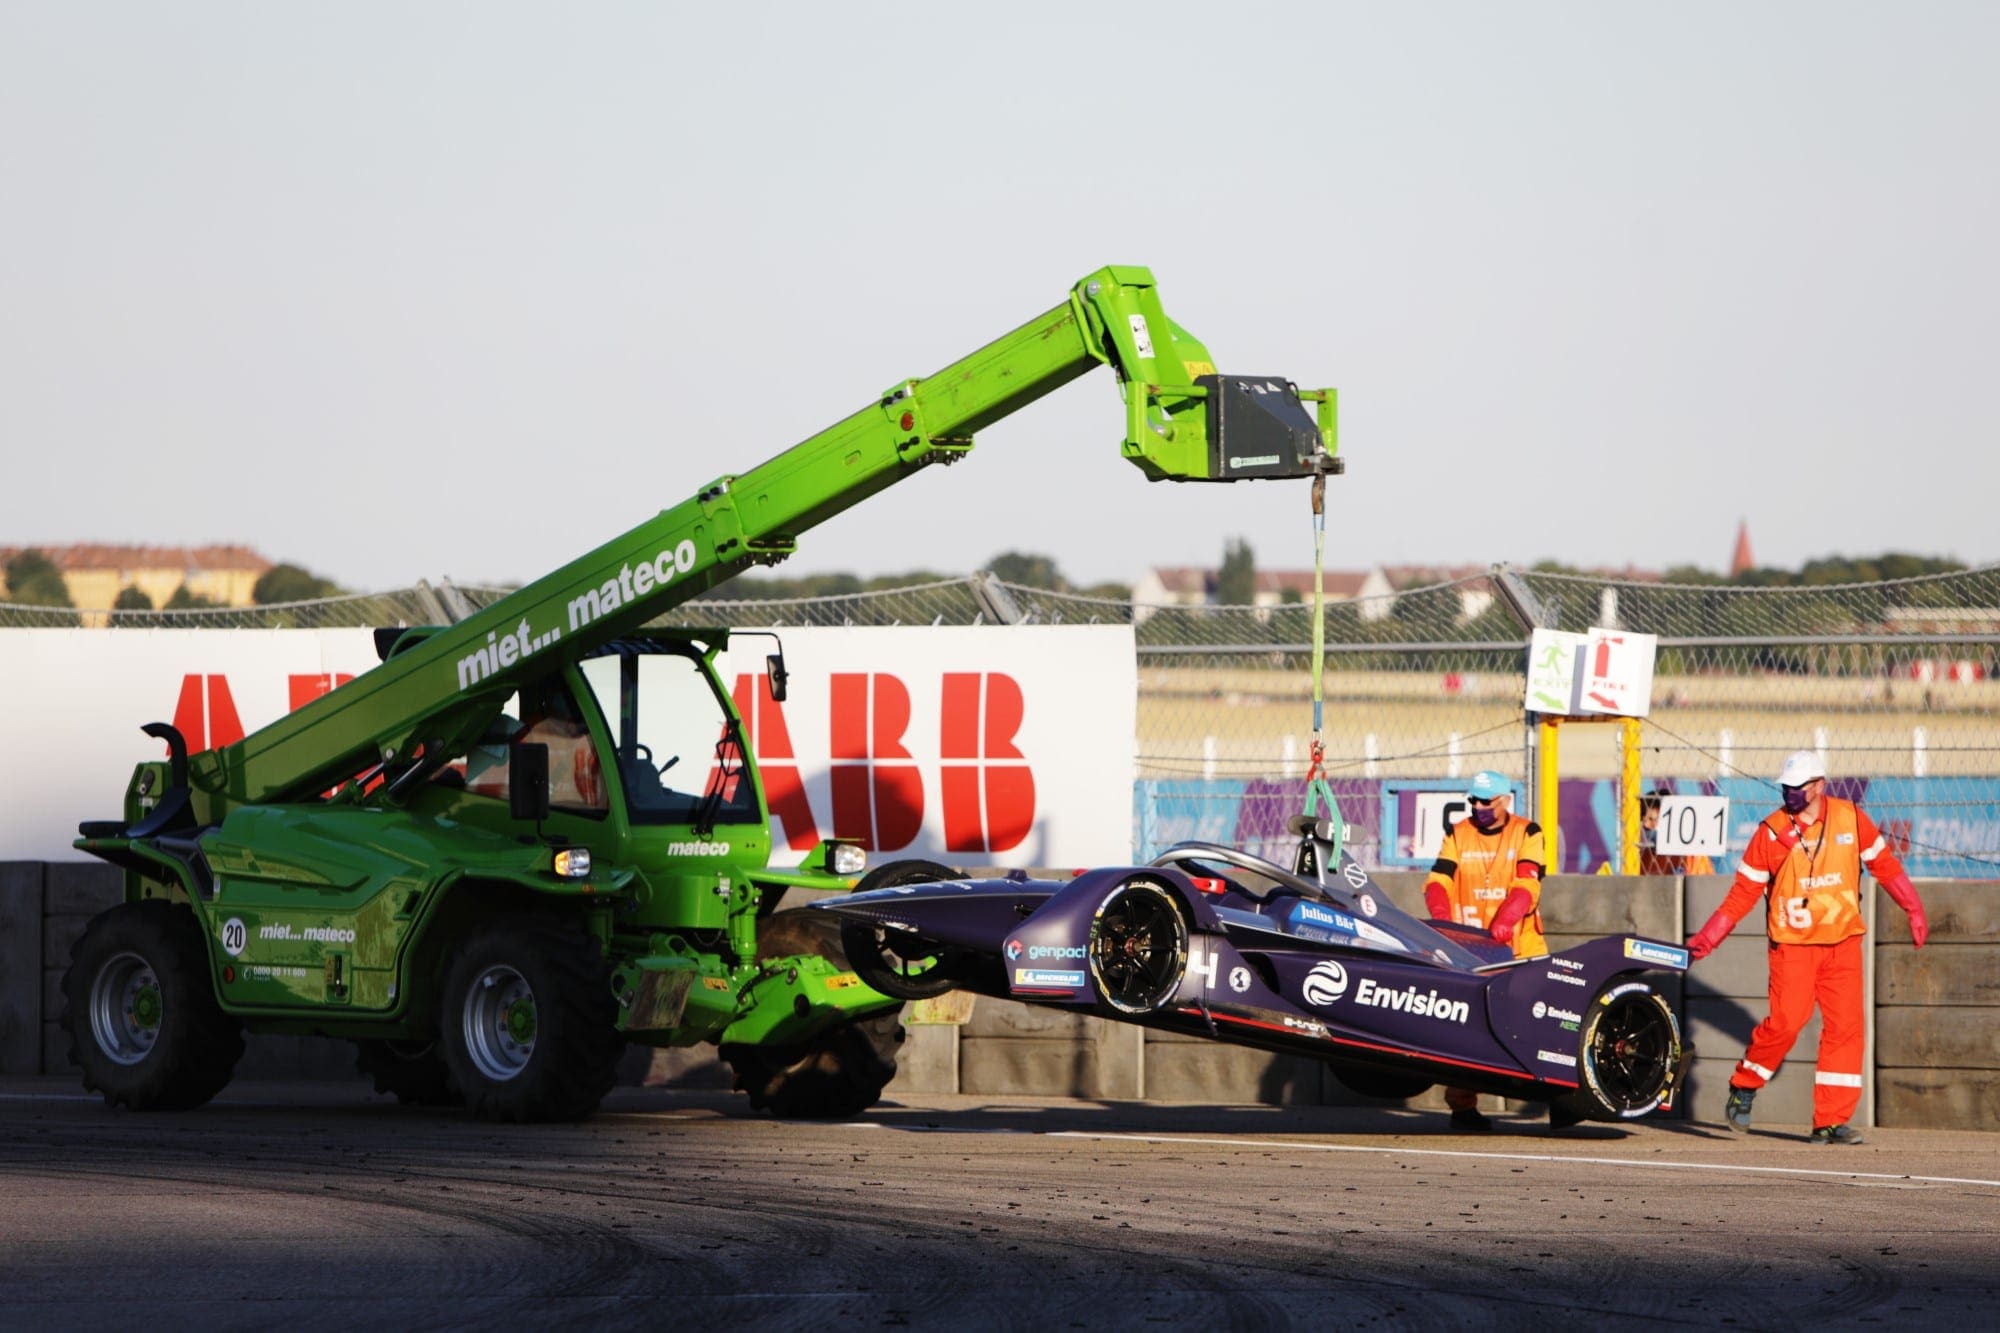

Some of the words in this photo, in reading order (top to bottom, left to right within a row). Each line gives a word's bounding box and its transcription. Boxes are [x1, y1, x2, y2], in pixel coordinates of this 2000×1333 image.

[457, 617, 561, 691] miet...
[567, 539, 697, 632] mateco
[699, 672, 1036, 853] ABB
[1662, 806, 1724, 846] 10.1
[667, 840, 730, 857] mateco
[1799, 872, 1843, 891] TRACK
[1301, 905, 1334, 924] Julius
[226, 924, 243, 949] 20
[259, 922, 301, 940] miet...
[303, 926, 356, 943] mateco
[1028, 944, 1087, 961] genpact
[1191, 951, 1219, 989] 4
[1551, 956, 1585, 970] HARLEY
[1547, 970, 1587, 987] DAVIDSON
[1354, 977, 1470, 1024] Envision
[1548, 1006, 1582, 1023] Envision
